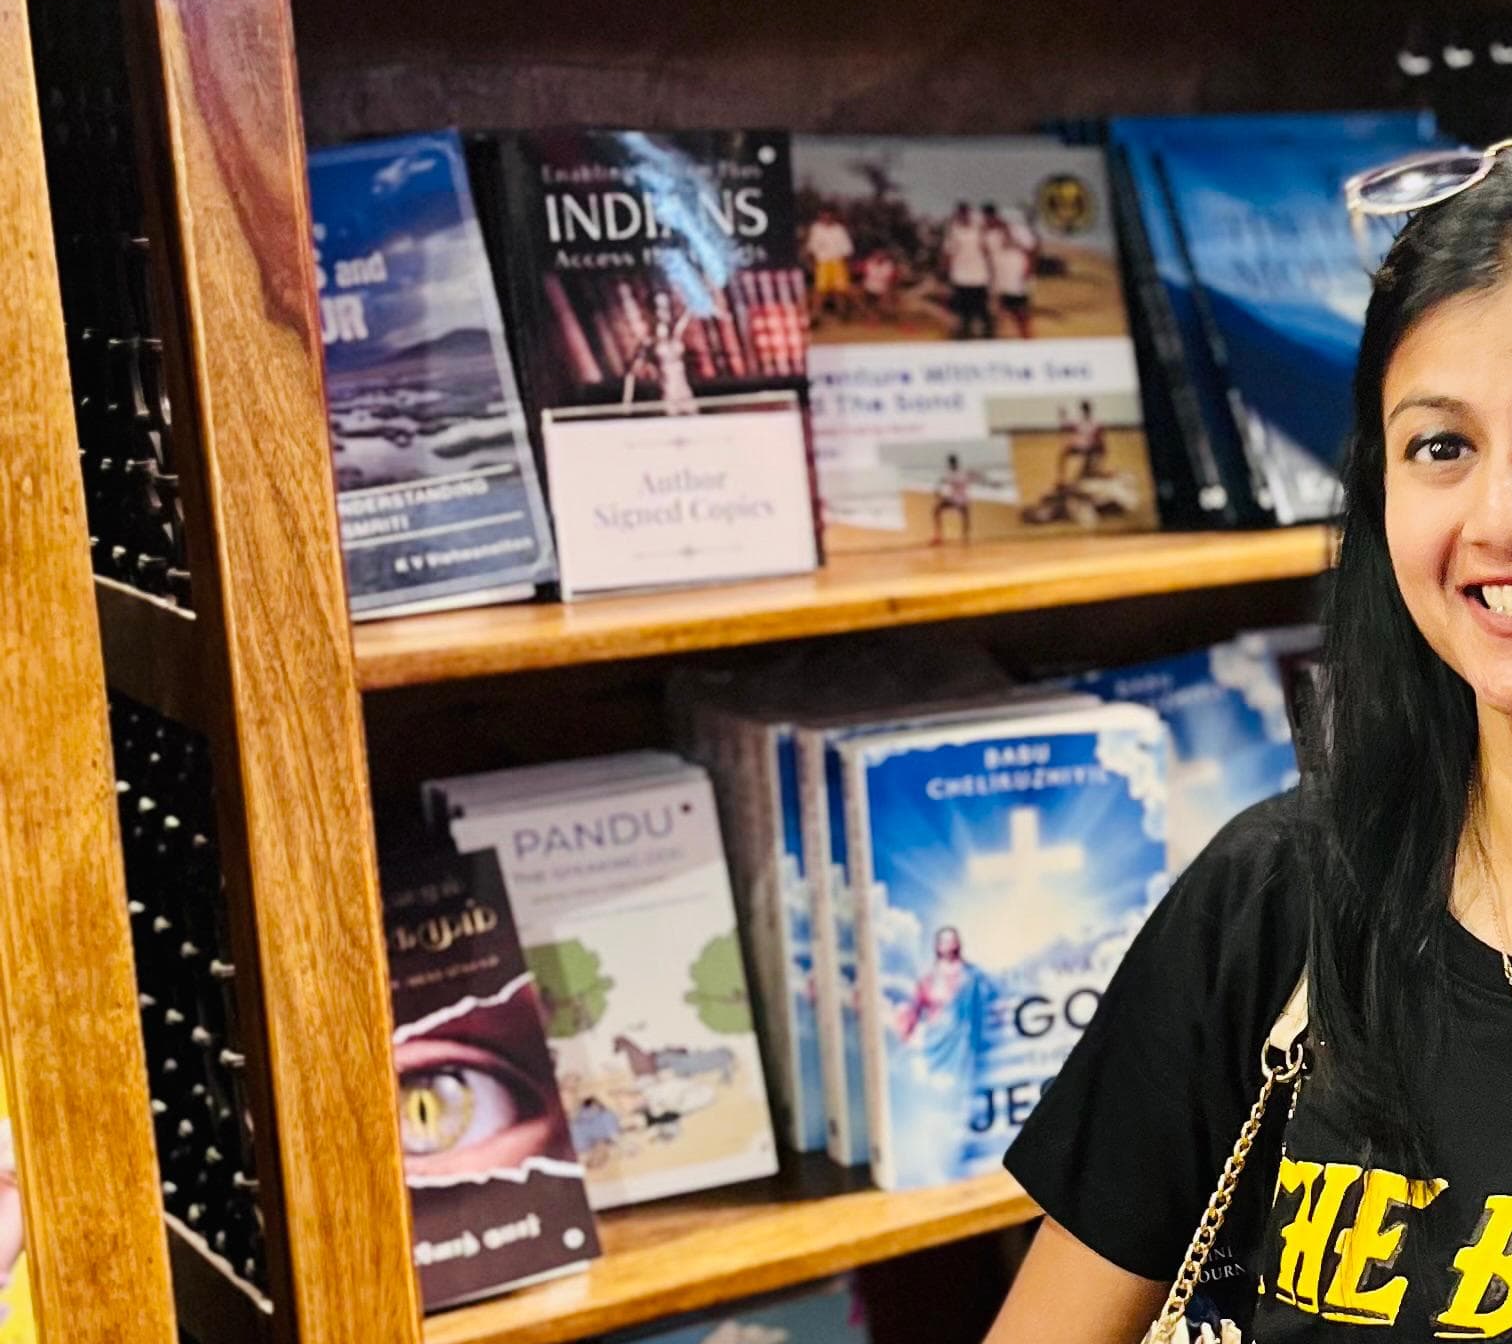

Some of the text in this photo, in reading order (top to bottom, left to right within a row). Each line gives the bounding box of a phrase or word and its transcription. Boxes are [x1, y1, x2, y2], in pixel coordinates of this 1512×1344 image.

[641, 466, 728, 495] Author
[593, 498, 777, 534] Signed Copies
[983, 742, 1052, 770] BABU
[513, 803, 674, 860] PANDU
